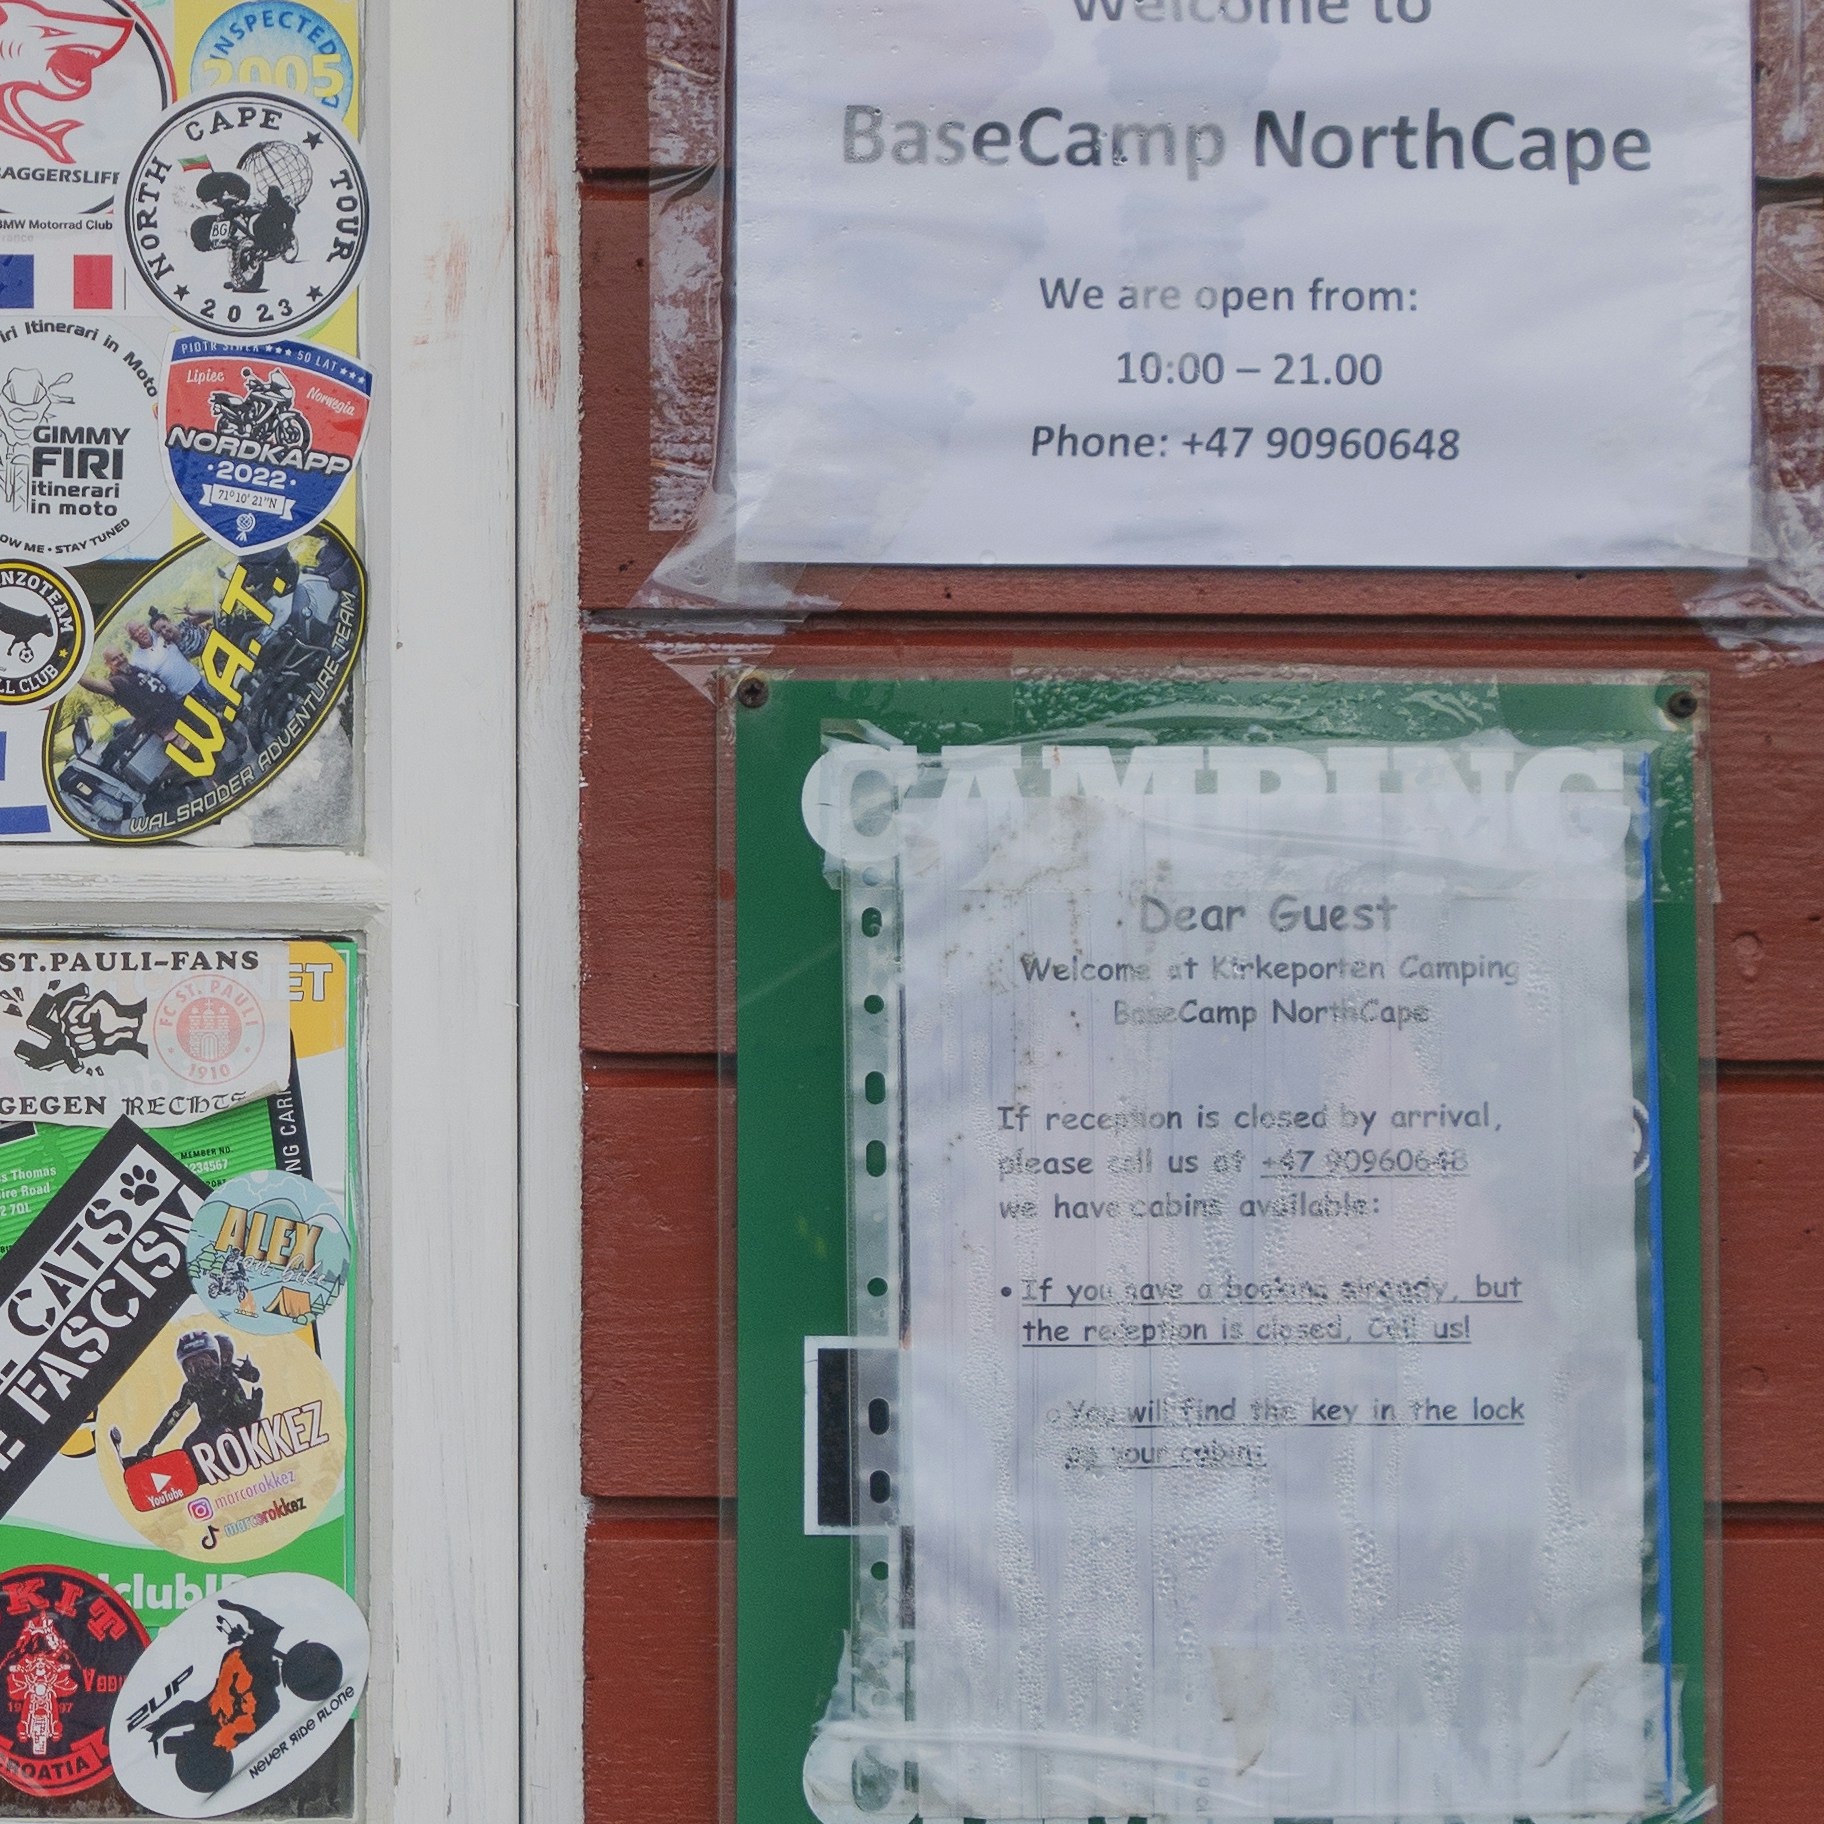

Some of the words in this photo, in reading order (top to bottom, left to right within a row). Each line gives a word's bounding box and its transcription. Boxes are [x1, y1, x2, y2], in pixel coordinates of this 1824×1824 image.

[841, 105, 1226, 181] BaseCamp
[1254, 109, 1652, 185] NorthCape
[25, 220, 75, 229] Motorrad
[80, 219, 112, 230] Club
[1039, 277, 1105, 311] We
[1118, 281, 1180, 311] are
[1194, 279, 1296, 321] open
[1309, 275, 1418, 311] from:
[1116, 351, 1224, 385] 10:00
[1273, 353, 1382, 387] 21.00
[33, 425, 130, 445] GIMMY
[167, 428, 352, 475] NORDKAPP
[1031, 424, 1167, 460] Phone:
[1180, 426, 1252, 460] +47
[1265, 426, 1460, 462] 90960648
[32, 448, 125, 480] FIRI
[216, 469, 287, 488] 2022
[31, 482, 120, 499] itinerari
[31, 501, 51, 514] in
[56, 501, 118, 518] moto
[1138, 897, 1247, 933] Dear
[1269, 895, 1398, 933] Guest
[0, 951, 259, 971] ST.PAULI-FANS
[1022, 954, 1151, 983] Welcome
[1210, 954, 1390, 989] Kirkeporten
[1400, 954, 1519, 984] Camping
[1113, 999, 1258, 1031] BaseCamp
[1272, 999, 1428, 1029] NorthCape
[191, 1401, 330, 1486] ROKKEZ
